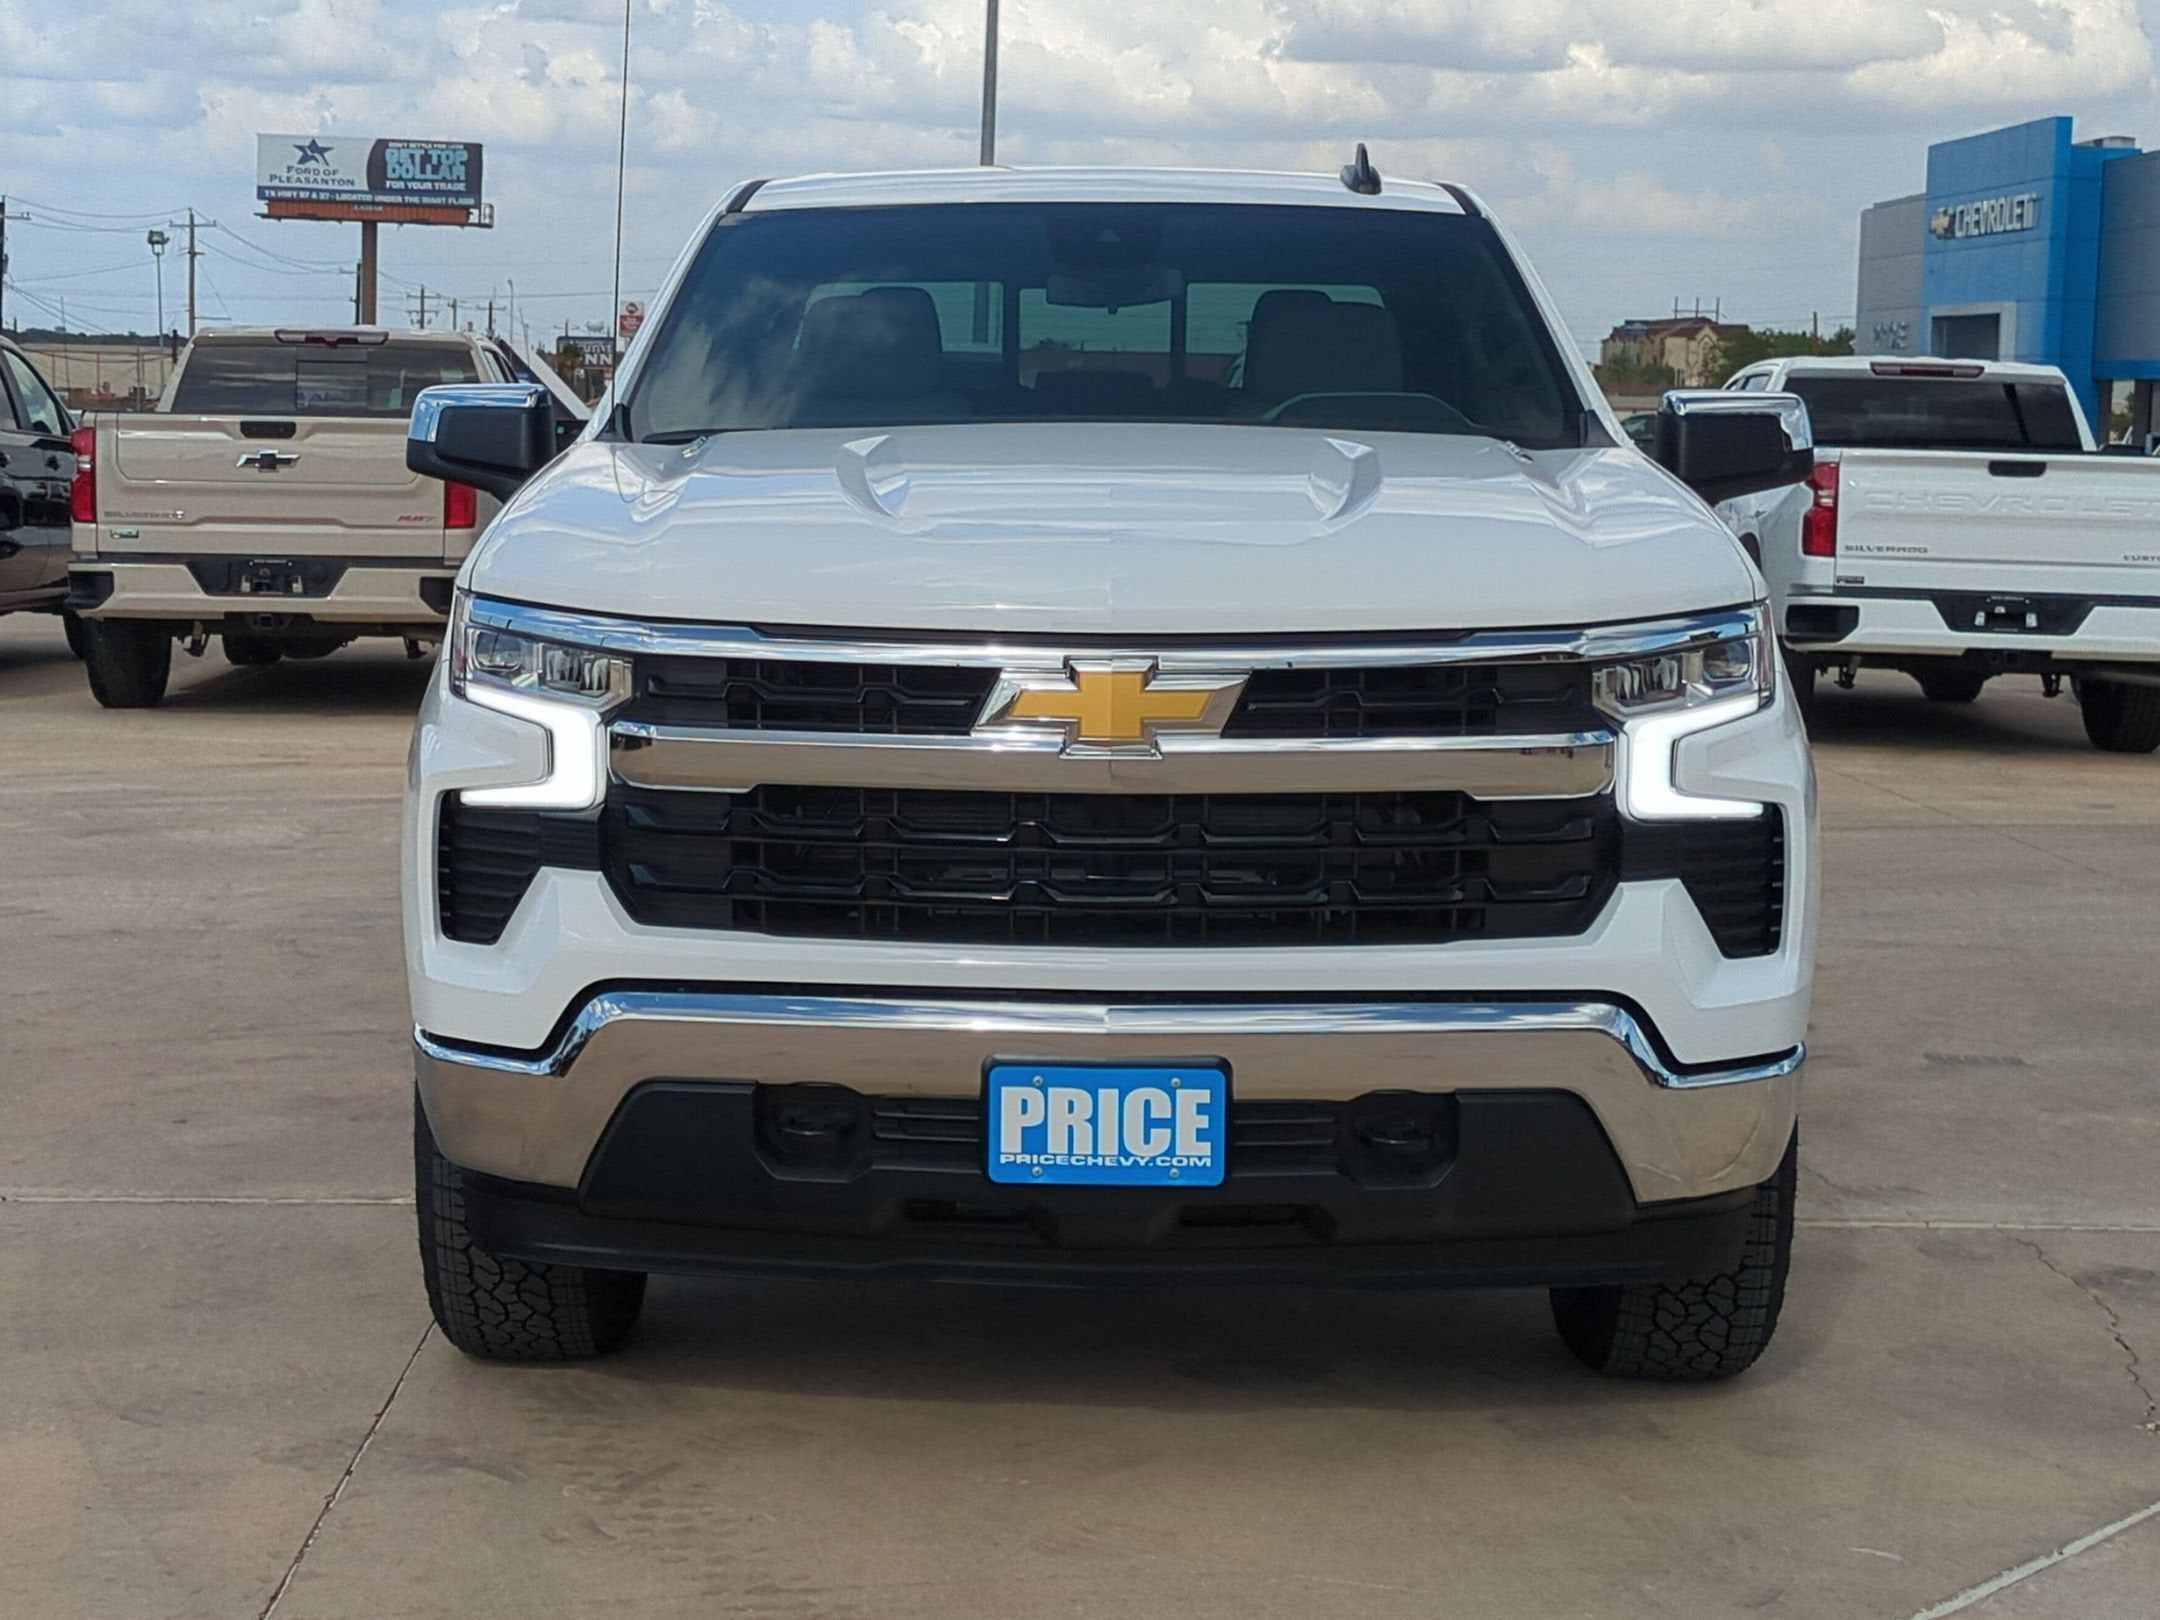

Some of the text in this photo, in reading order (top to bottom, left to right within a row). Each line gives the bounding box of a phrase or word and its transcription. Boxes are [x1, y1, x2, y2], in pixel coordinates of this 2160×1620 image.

[427, 149, 468, 165] TOP
[286, 165, 340, 177] FORD OF
[269, 174, 355, 187] PLEASANTON
[386, 181, 466, 191] FOR YOUR TRADE
[1954, 195, 2034, 238] CHEVROLET
[1865, 490, 2160, 519] CHEVROLE
[1844, 544, 1928, 554] SILVERADO
[1000, 1086, 1212, 1157] PRICE
[1000, 1153, 1212, 1167] PRICECHEVY.COM
